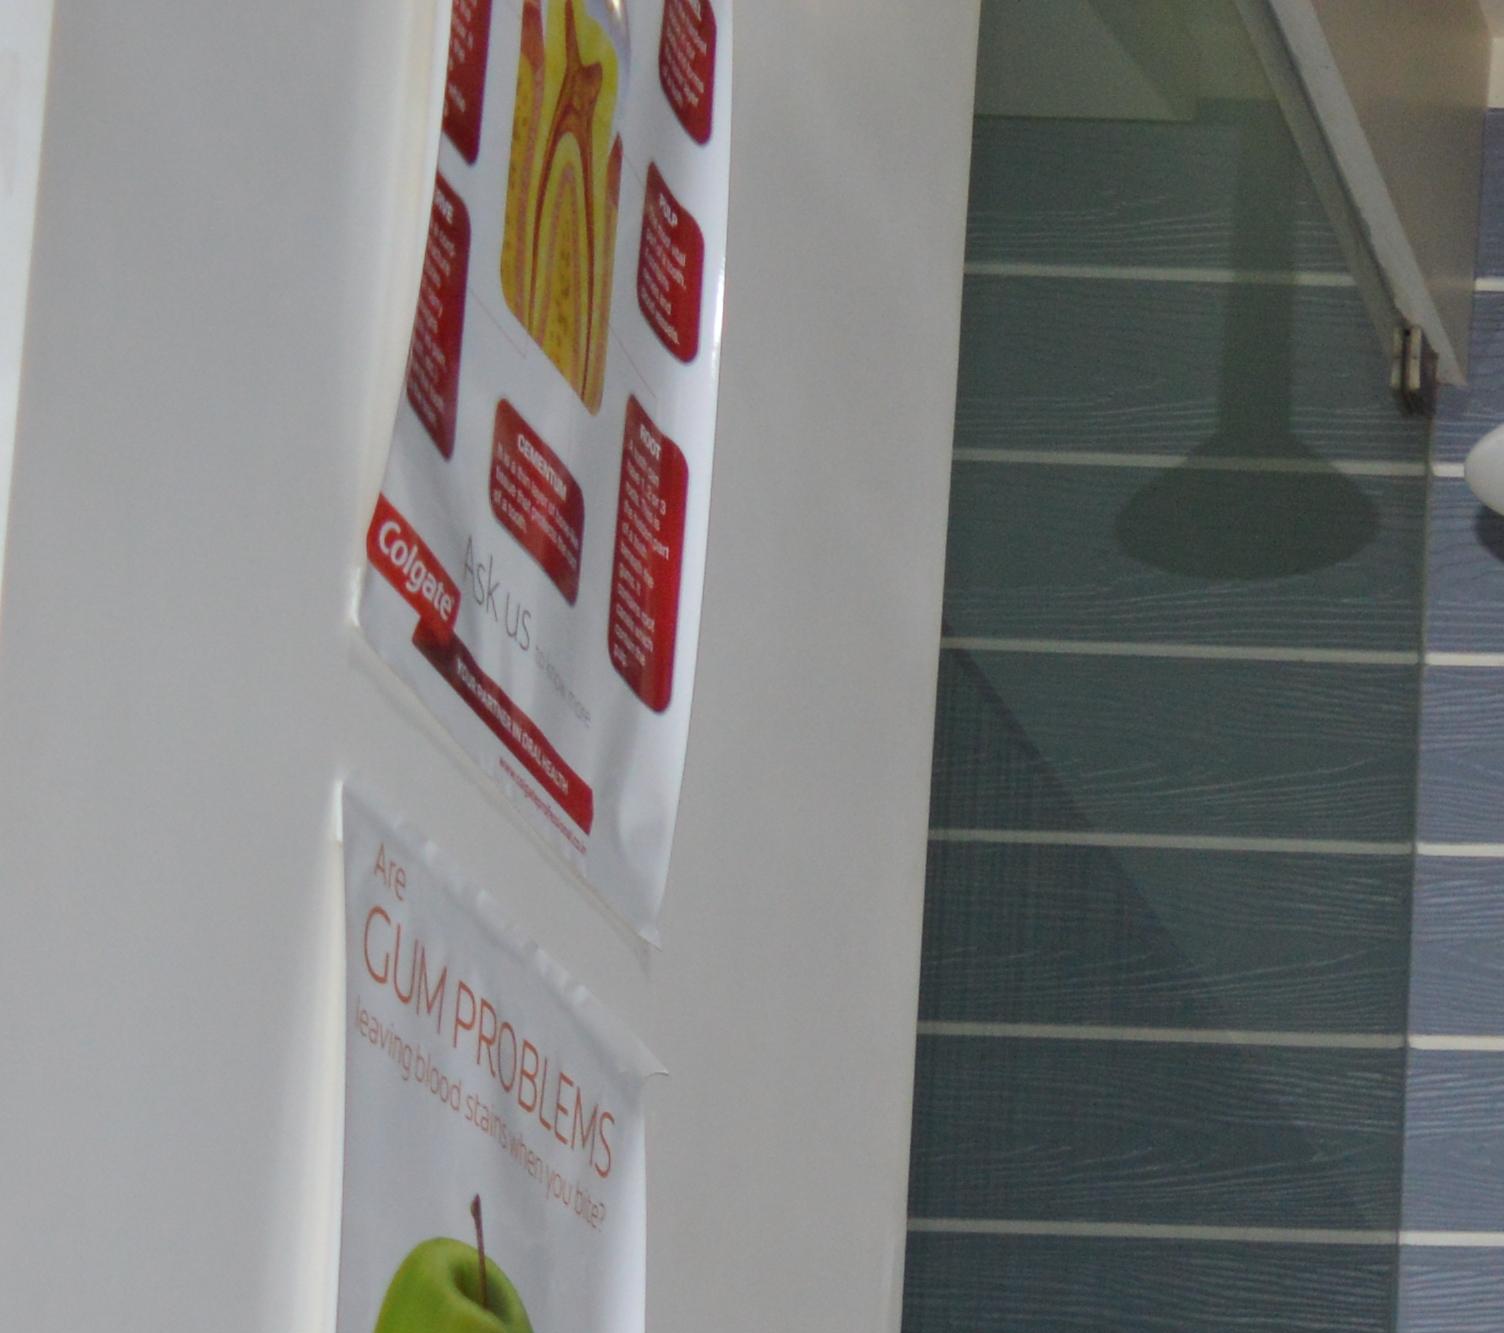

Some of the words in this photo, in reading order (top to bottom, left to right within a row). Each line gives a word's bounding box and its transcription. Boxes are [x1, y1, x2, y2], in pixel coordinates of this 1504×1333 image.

[518, 433, 568, 501] CEMENTUM
[640, 423, 661, 461] ROOT
[380, 521, 453, 620] Colgate
[463, 536, 500, 622] Ask
[506, 592, 531, 651] us
[374, 843, 406, 901] Are
[364, 906, 447, 1035] GUM
[453, 981, 615, 1178] PROBLEMS
[355, 995, 412, 1081] leaving
[415, 1046, 461, 1111] blood
[466, 1094, 507, 1149] stains
[509, 1132, 543, 1183] when
[546, 1164, 570, 1208] you
[575, 1186, 604, 1232] bite?
